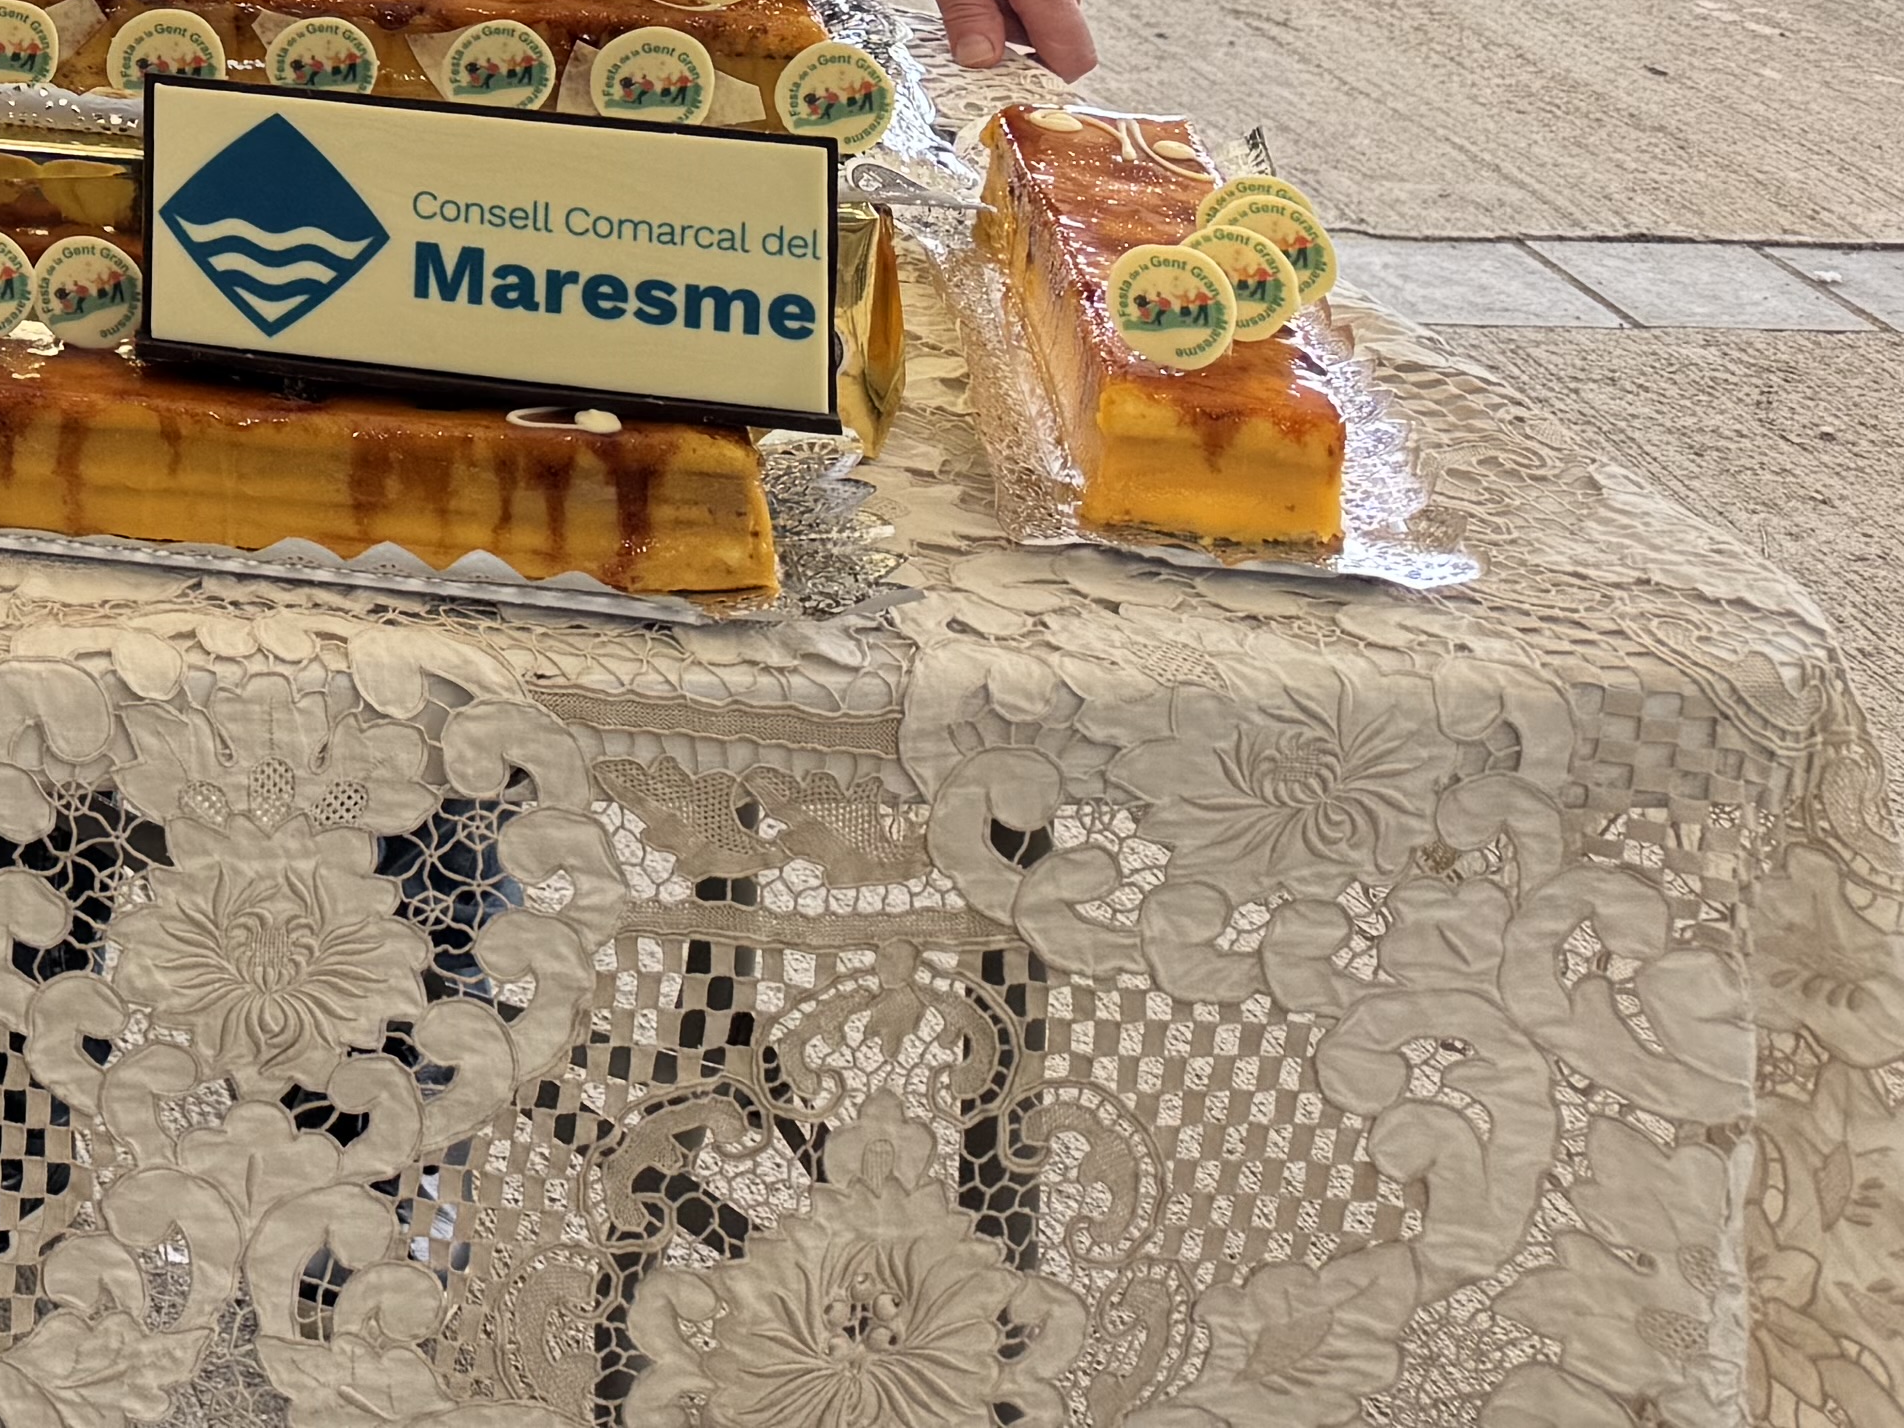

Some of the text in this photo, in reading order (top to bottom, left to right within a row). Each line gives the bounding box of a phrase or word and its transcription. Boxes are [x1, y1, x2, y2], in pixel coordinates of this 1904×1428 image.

[817, 55, 852, 65] Gent
[855, 58, 882, 84] Gran
[412, 190, 821, 261] Consell Comarcal del
[62, 245, 95, 258] Gent
[100, 247, 129, 273] Gran
[1118, 279, 1132, 317] Festa
[1150, 256, 1187, 271] Gent
[1191, 266, 1219, 297] Gran
[413, 240, 817, 340] Maresme
